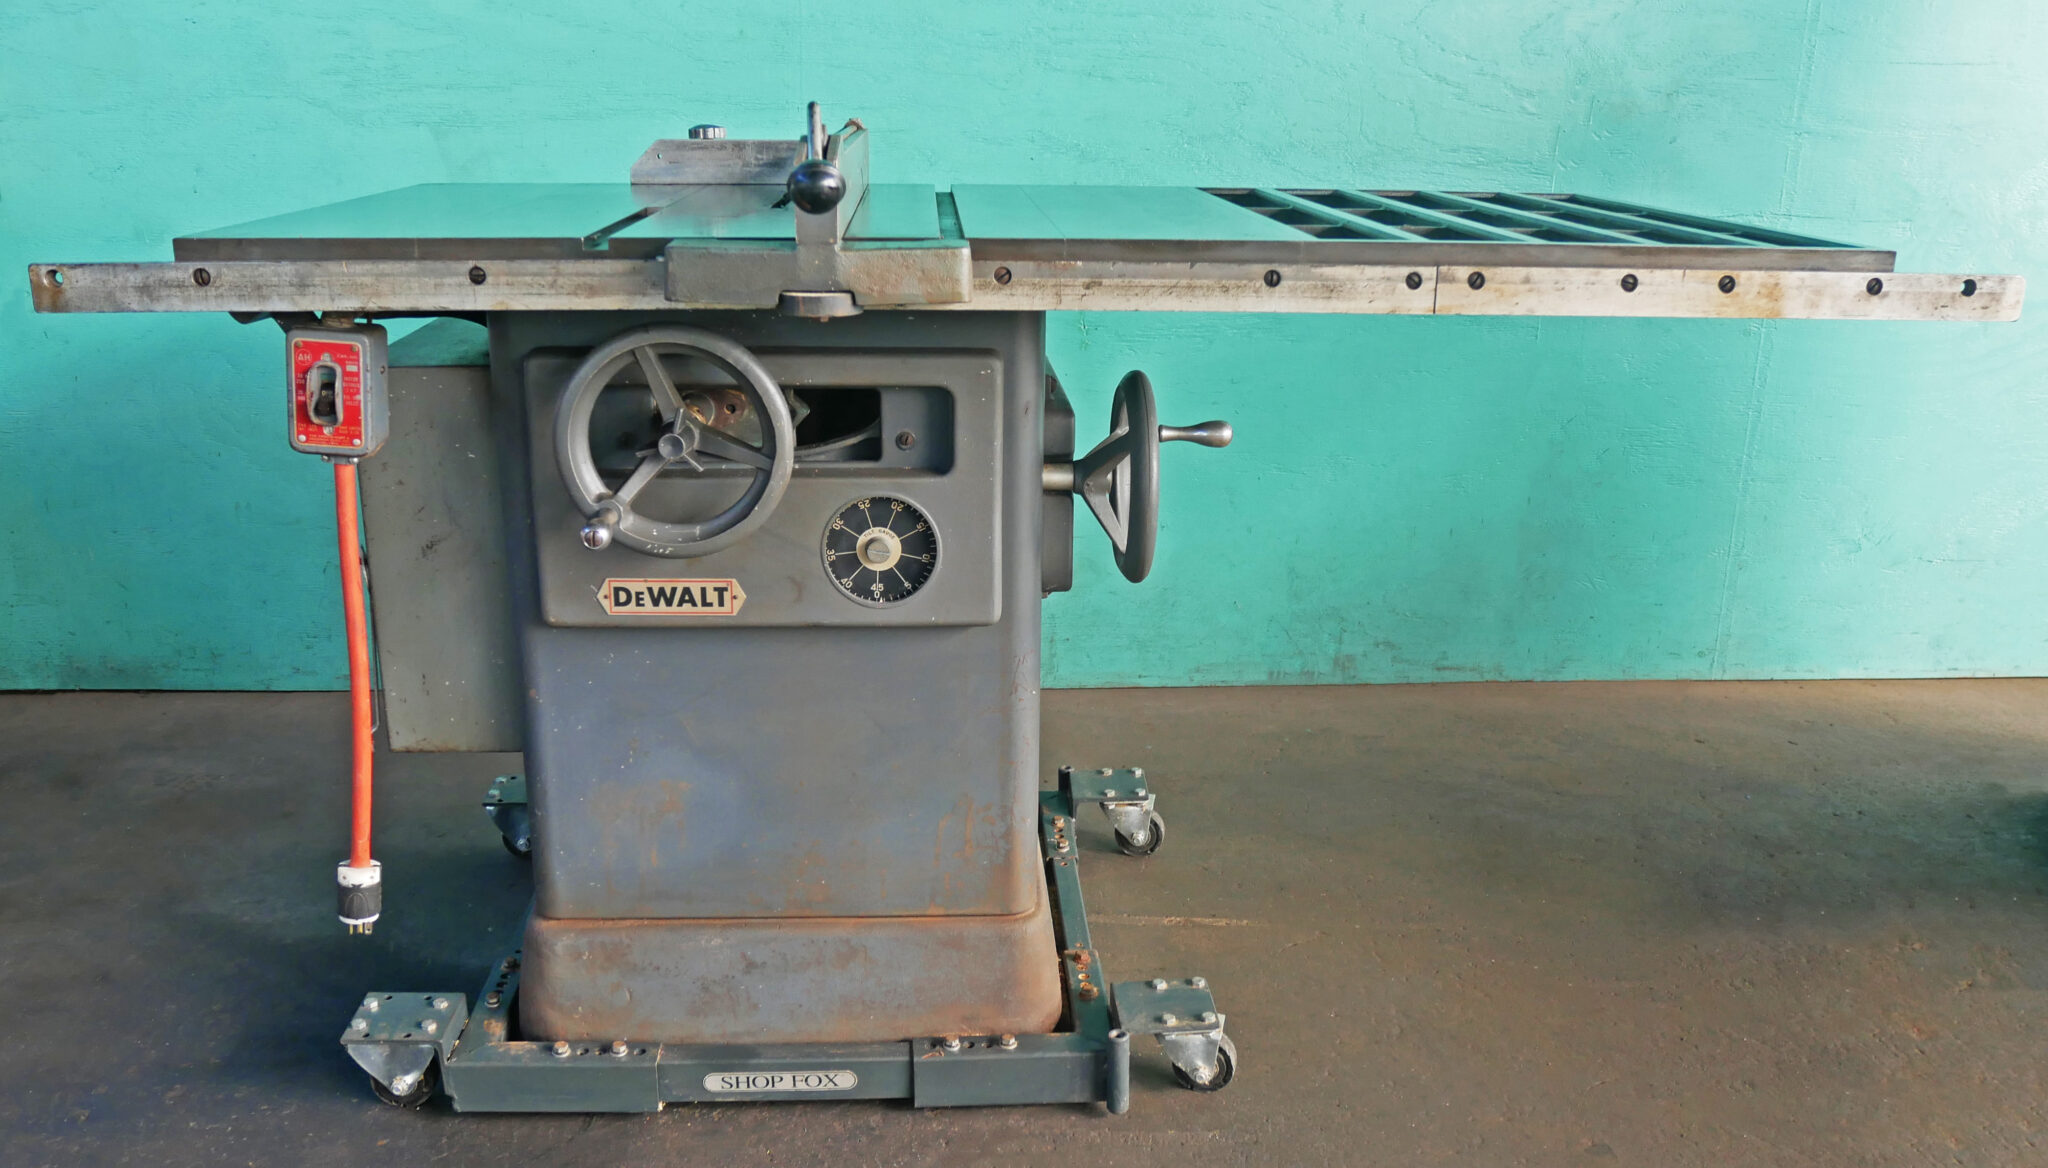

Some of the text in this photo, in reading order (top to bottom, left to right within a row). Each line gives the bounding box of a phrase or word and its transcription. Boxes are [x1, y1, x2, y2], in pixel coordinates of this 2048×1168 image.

[857, 500, 871, 509] 25
[891, 501, 904, 512] 20
[832, 517, 843, 530] 30
[916, 522, 926, 532] 15
[826, 548, 836, 561] 35
[922, 553, 931, 563] 10
[840, 577, 853, 588] 40
[870, 583, 884, 592] 45
[904, 581, 912, 590] 5
[613, 586, 729, 608] DEWALT
[873, 591, 880, 599] 0
[720, 1073, 839, 1090] SHOP FOX
